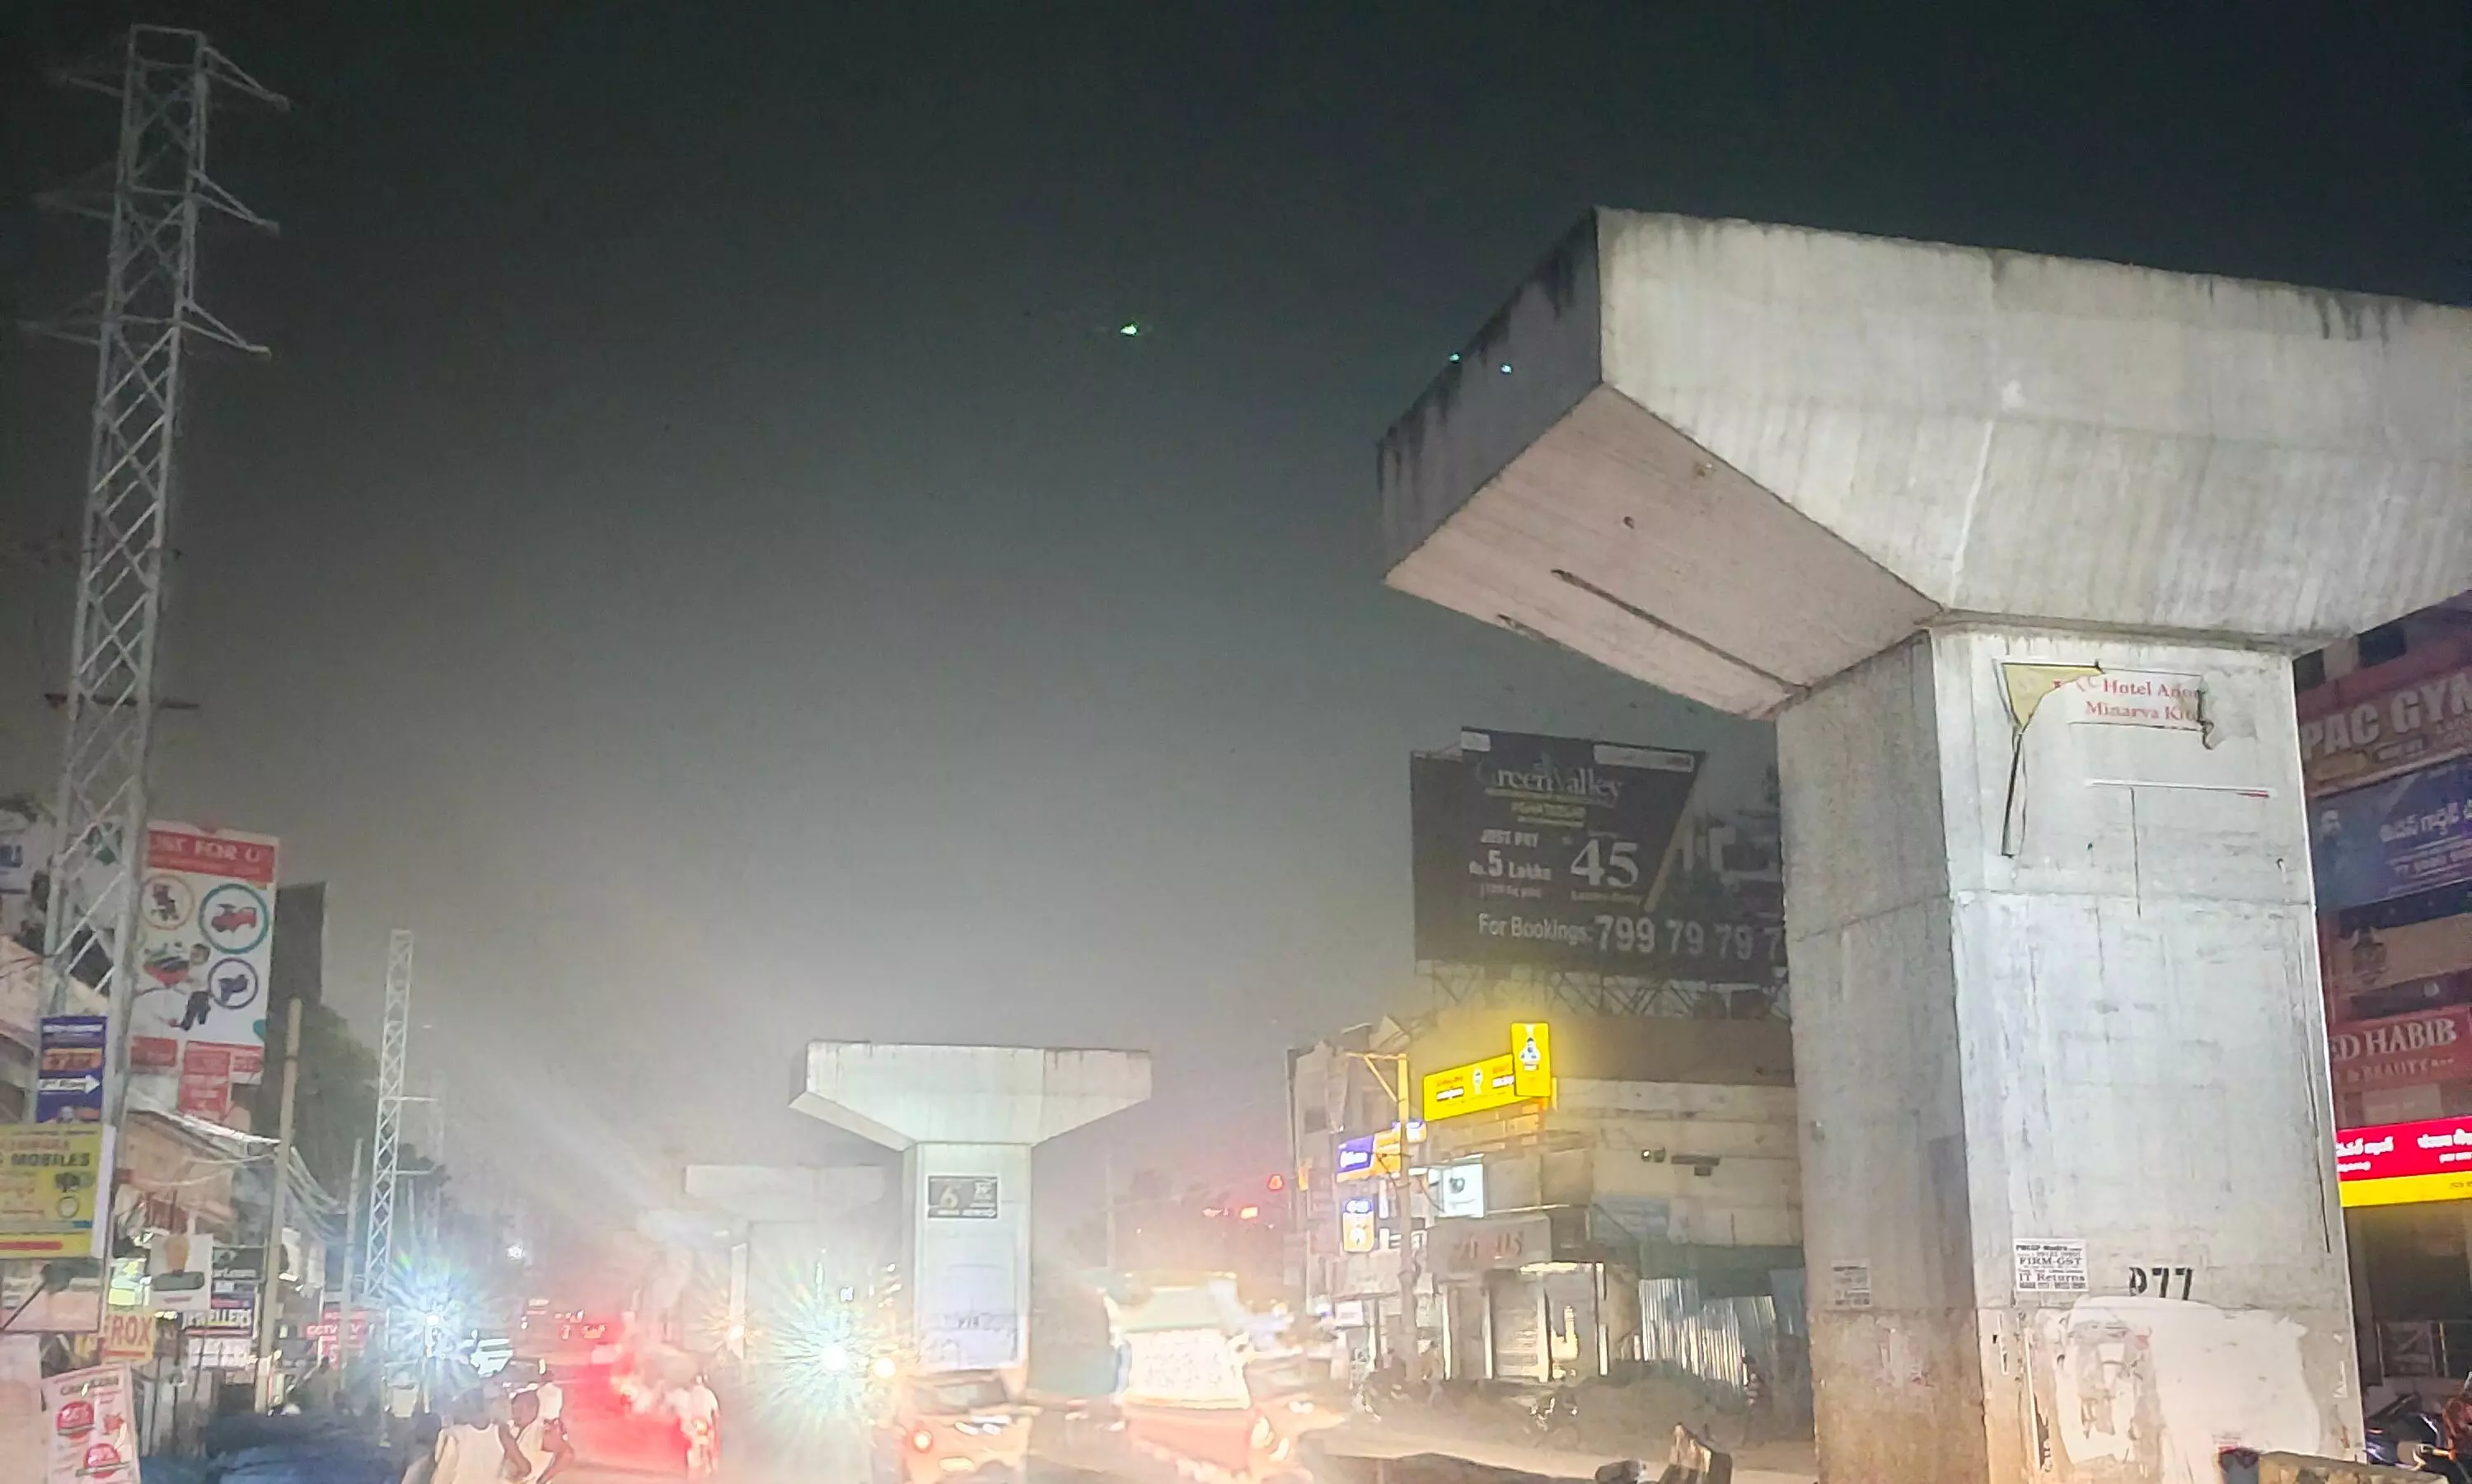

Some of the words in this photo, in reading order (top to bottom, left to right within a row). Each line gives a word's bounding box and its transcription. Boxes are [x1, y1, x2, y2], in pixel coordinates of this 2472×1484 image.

[2103, 677, 2151, 697] Hotel
[2086, 700, 2160, 720] Minarva
[2300, 704, 2381, 761] PAC
[194, 840, 238, 861] FOR
[1487, 849, 1504, 877] 5
[1570, 838, 1640, 888] 45
[1478, 913, 1505, 937] For
[1594, 915, 1655, 953] 799
[1664, 919, 1705, 956] 79
[1713, 922, 1754, 961] 79
[2363, 1018, 2457, 1057] HABIB
[11, 1153, 90, 1167] MOBILES
[2019, 1272, 2030, 1281] IT
[2036, 1273, 2086, 1282] Returns
